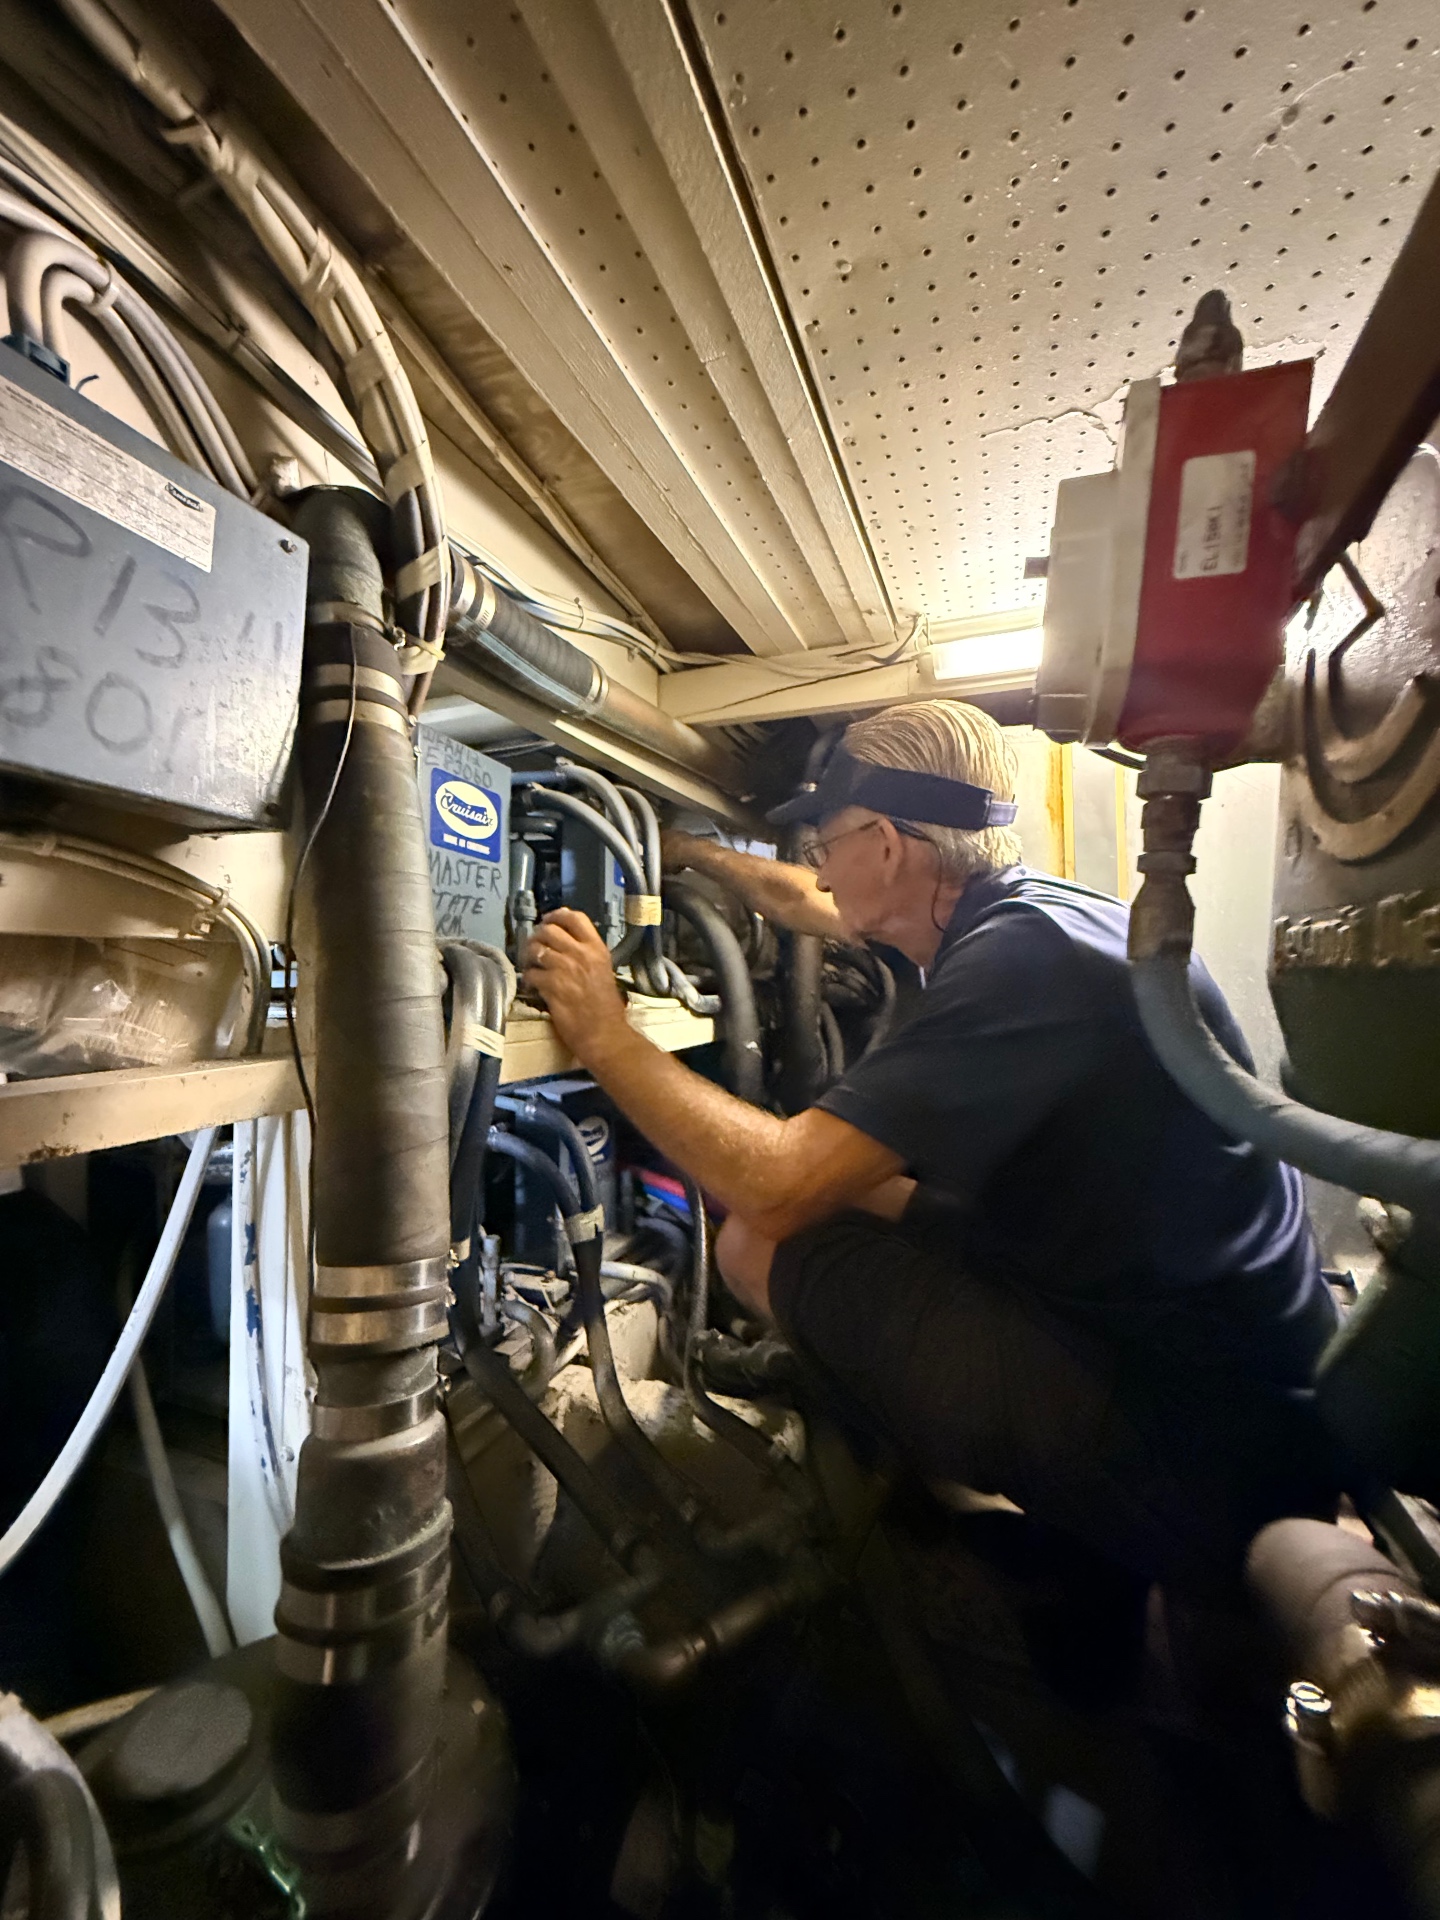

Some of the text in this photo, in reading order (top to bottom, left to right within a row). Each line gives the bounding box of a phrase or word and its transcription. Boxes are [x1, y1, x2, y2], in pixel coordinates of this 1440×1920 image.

[440, 788, 493, 827] Cruisair
[428, 847, 502, 899] MASTER
[432, 888, 485, 915] TATE
